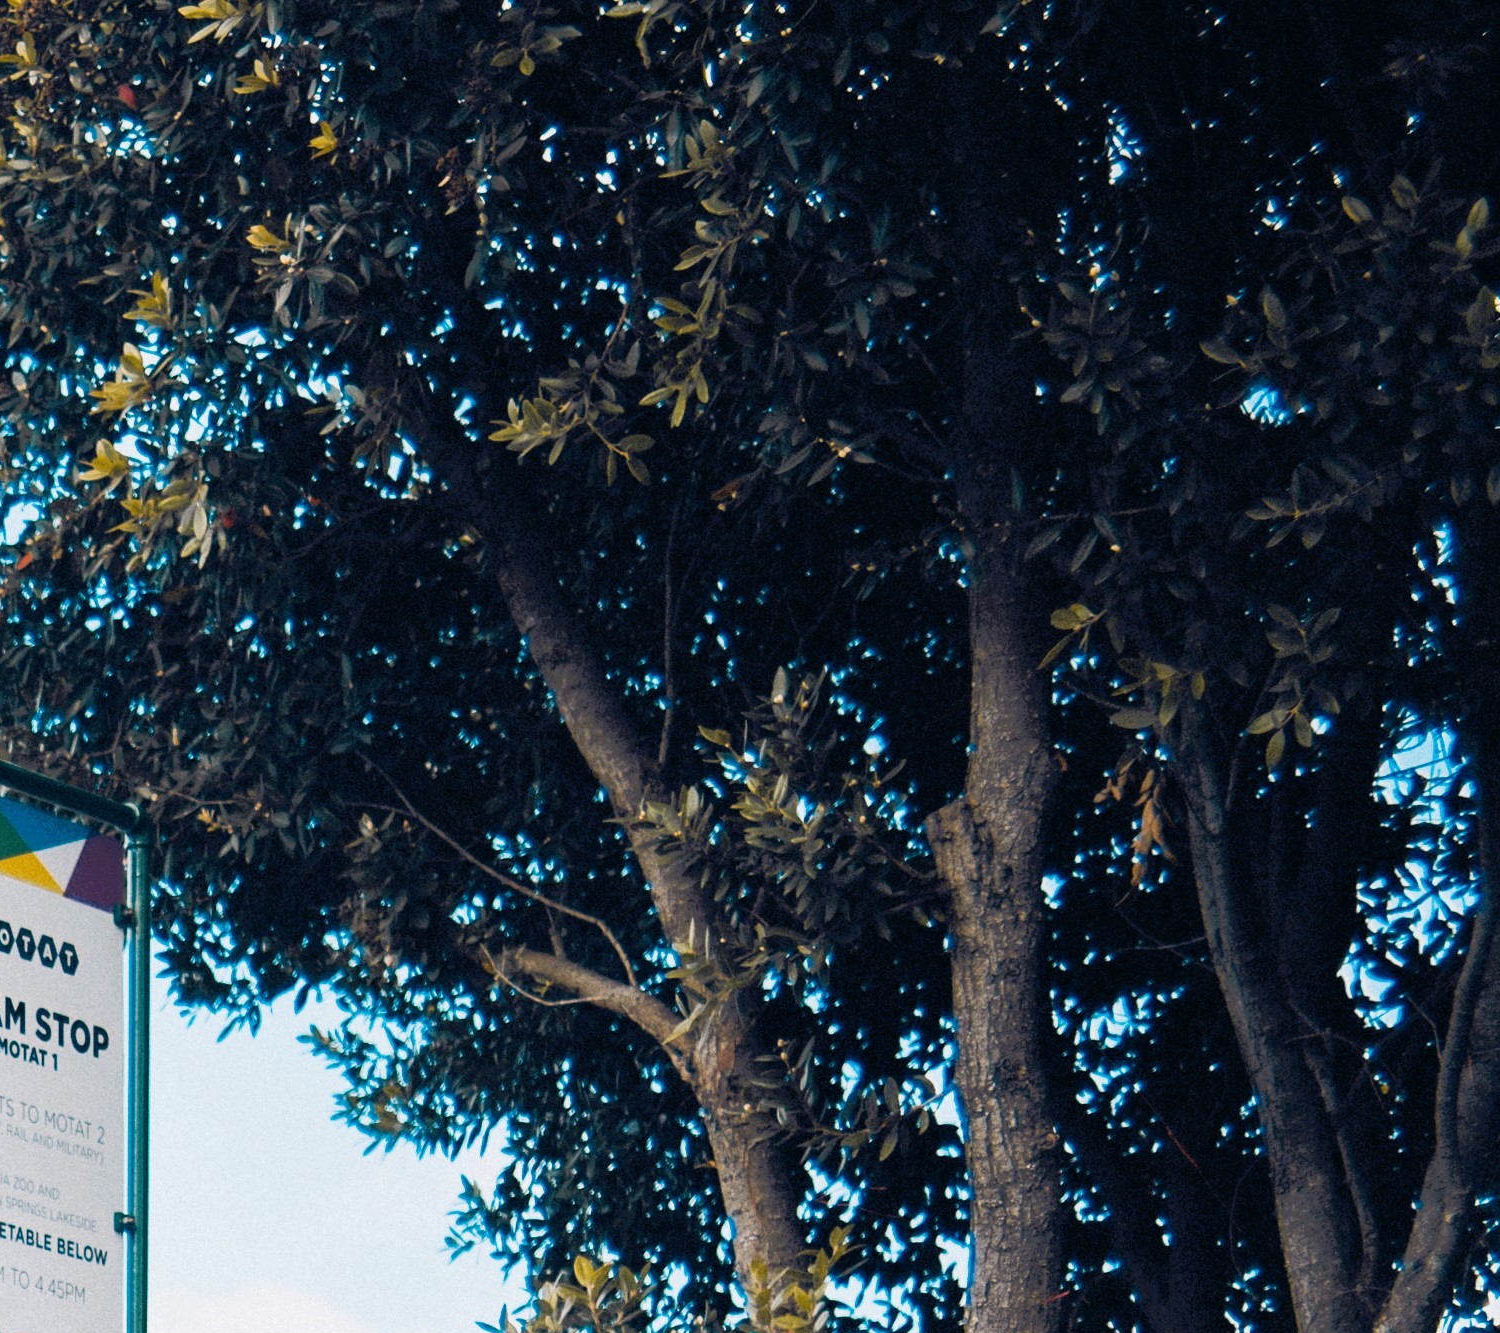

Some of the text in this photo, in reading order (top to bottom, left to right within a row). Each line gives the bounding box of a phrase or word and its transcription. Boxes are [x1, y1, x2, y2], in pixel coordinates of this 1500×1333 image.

[35, 1007, 109, 1059] STOP
[52, 1053, 58, 1071] 1
[20, 1101, 39, 1124] TO
[45, 1109, 92, 1140] MOTAT
[97, 1125, 105, 1145] 2
[7, 1124, 28, 1143] RAIL
[32, 1133, 53, 1150] AND
[13, 1177, 34, 1194] ZOO
[38, 1184, 59, 1200] AND
[6, 1197, 47, 1219] SPRINGS
[57, 1237, 108, 1266] BELOW
[11, 1267, 30, 1290] TO
[35, 1276, 86, 1304] 4.45PM
